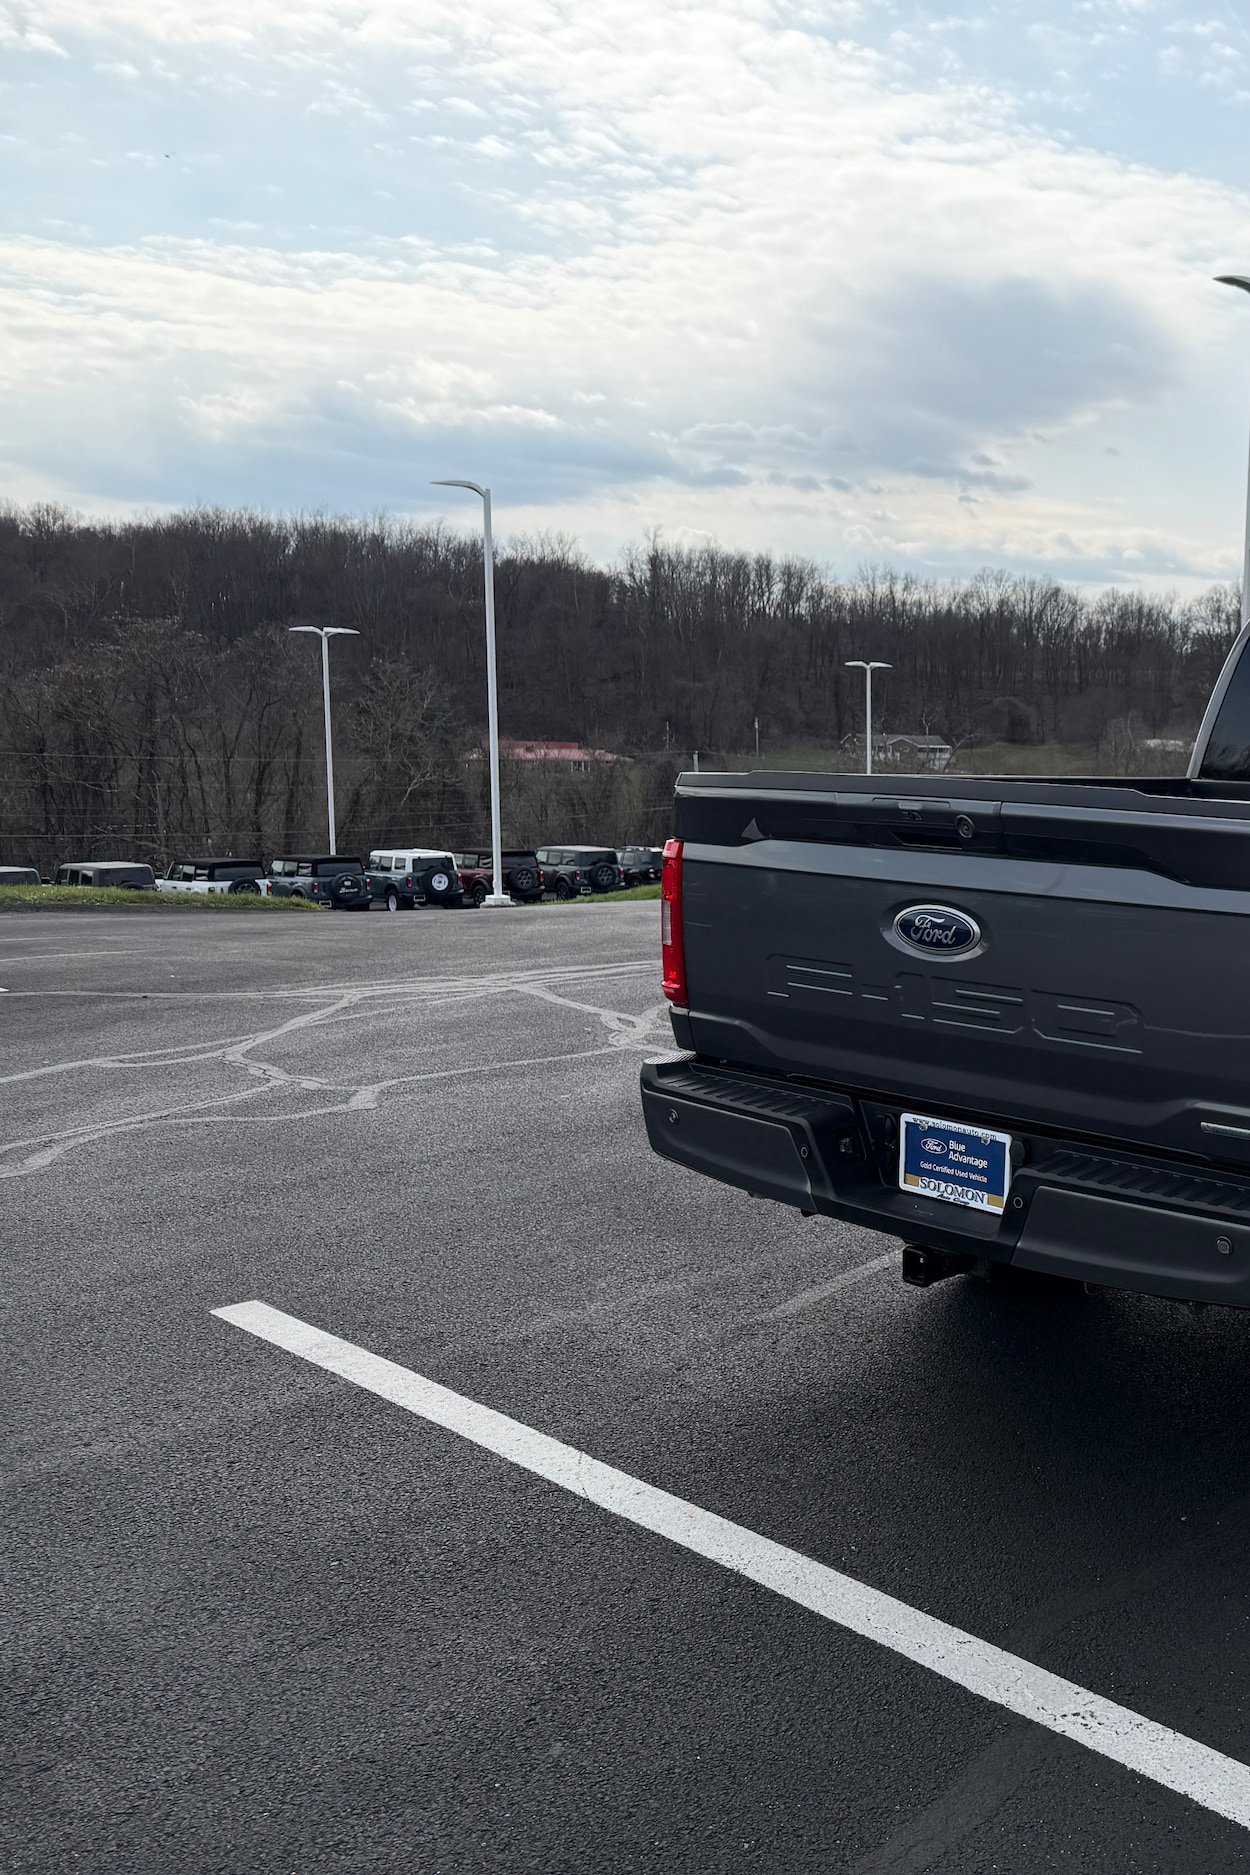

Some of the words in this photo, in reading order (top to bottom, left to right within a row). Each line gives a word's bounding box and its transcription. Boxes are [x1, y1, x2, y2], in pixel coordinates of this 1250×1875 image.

[911, 915, 957, 944] Ford
[766, 953, 1148, 1054] F-150
[925, 1140, 942, 1152] Ford
[949, 1140, 966, 1153] Blue
[948, 1152, 988, 1169] Advantage
[920, 1161, 932, 1170] Gold
[932, 1164, 955, 1176] Certified
[955, 1168, 968, 1179] Used
[969, 1172, 988, 1184] Vehicle
[920, 1178, 987, 1204] SOLOMON
